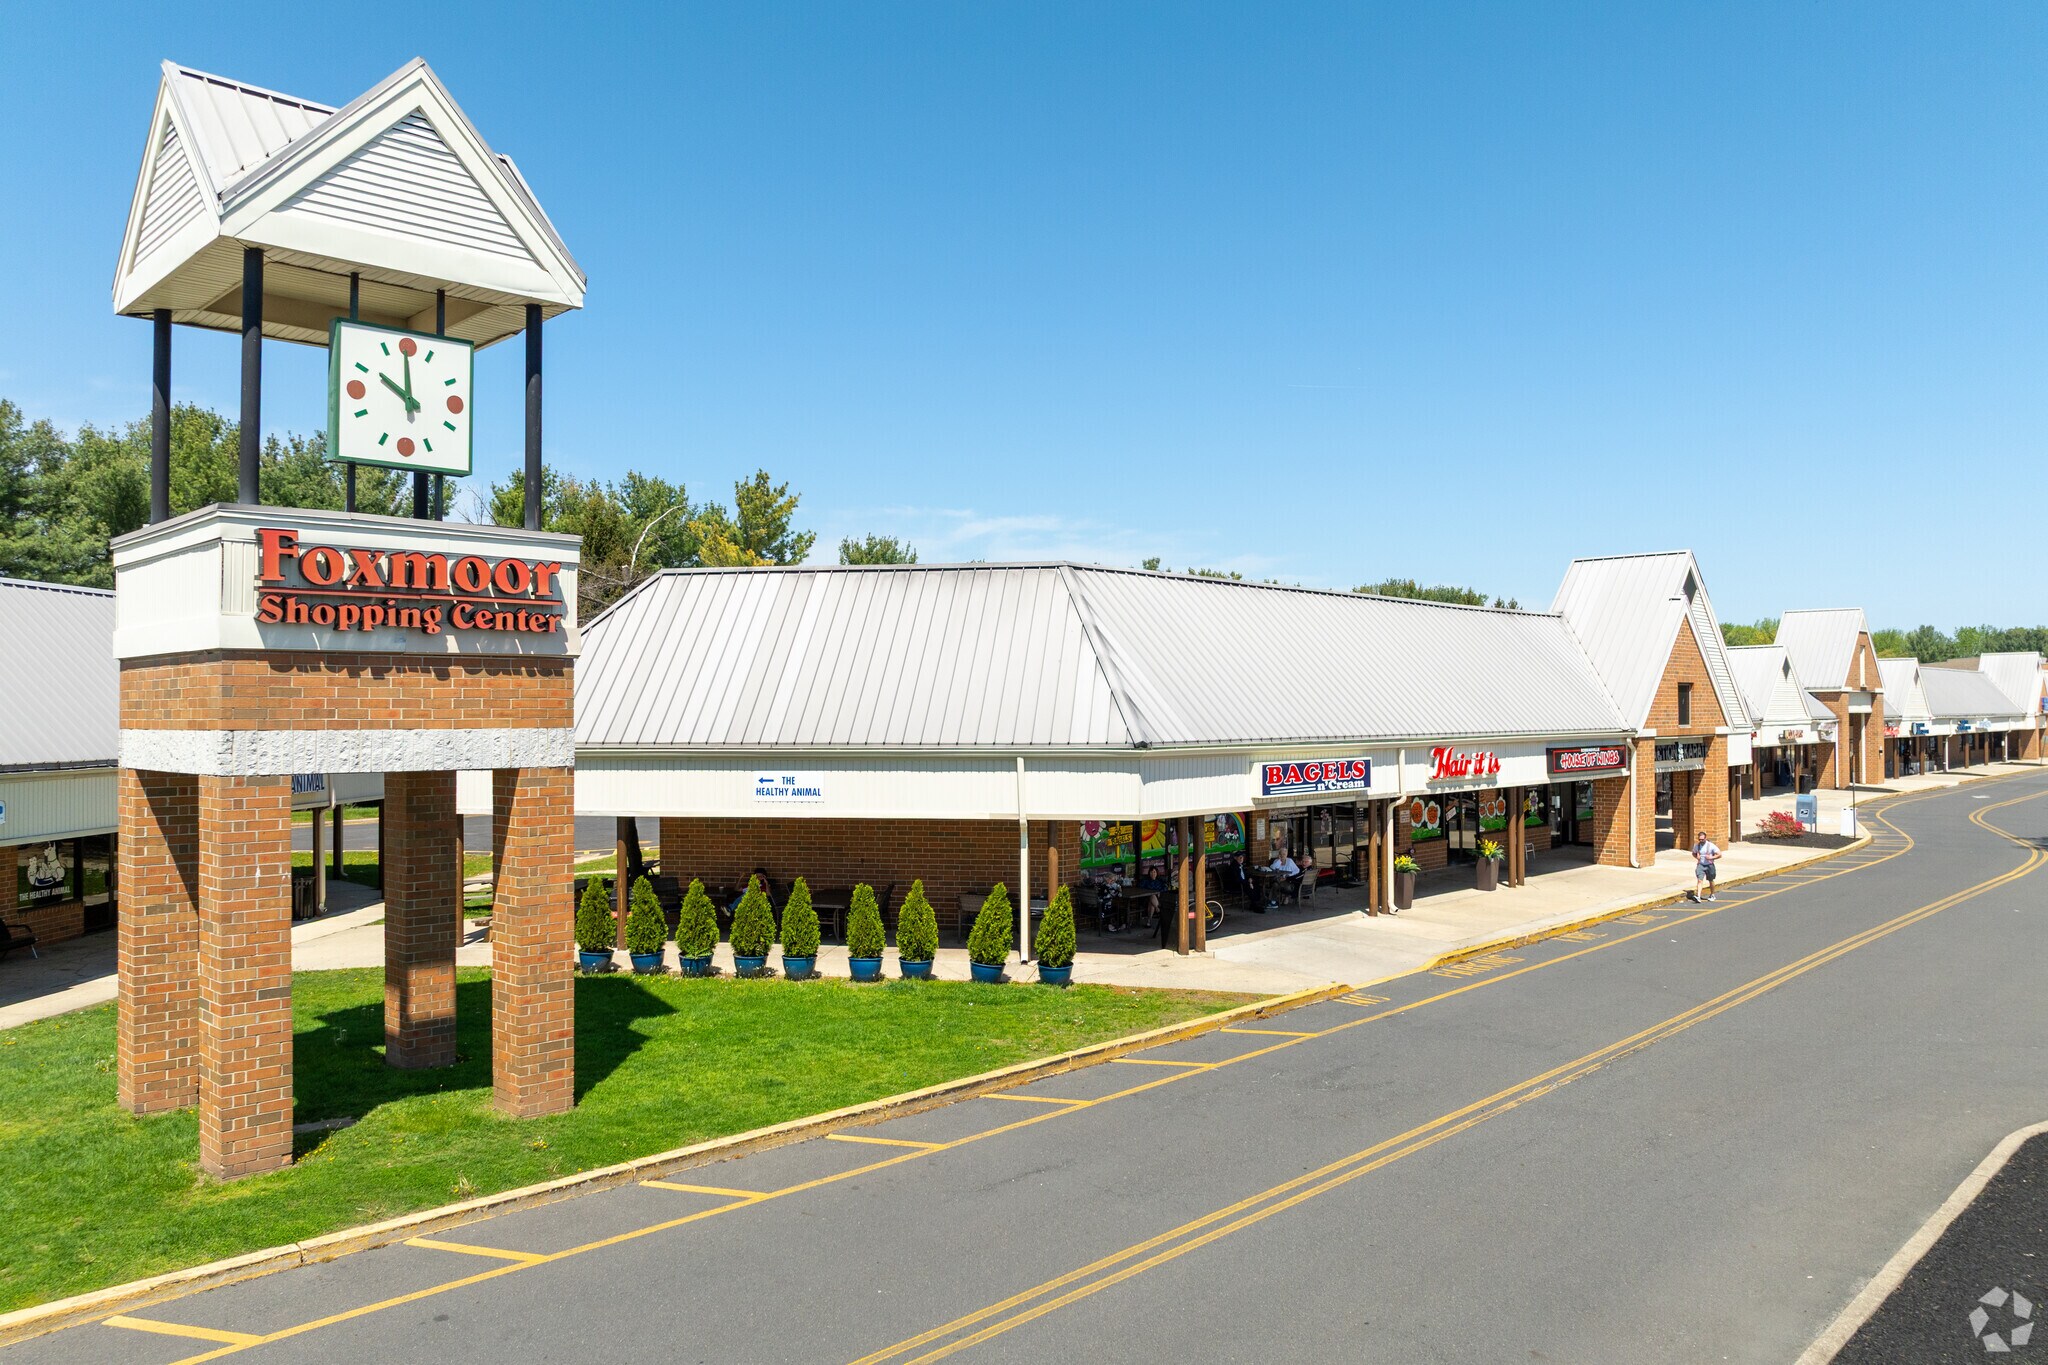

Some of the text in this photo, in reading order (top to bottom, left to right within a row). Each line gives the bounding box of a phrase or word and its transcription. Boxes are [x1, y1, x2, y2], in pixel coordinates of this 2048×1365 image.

[257, 528, 562, 596] Foxmoor
[256, 593, 563, 635] Shopping Center
[1432, 746, 1502, 779] Hair it is
[1559, 750, 1620, 770] HOUSE OF WINGS
[782, 776, 796, 785] THE
[1265, 760, 1366, 786] BAGELS
[292, 774, 325, 793] ANIMAL
[755, 787, 822, 797] HEALTHY ANIMAL
[1317, 780, 1365, 791] n'Cream
[19, 885, 71, 902] THE HEALTHY ANIMAL
